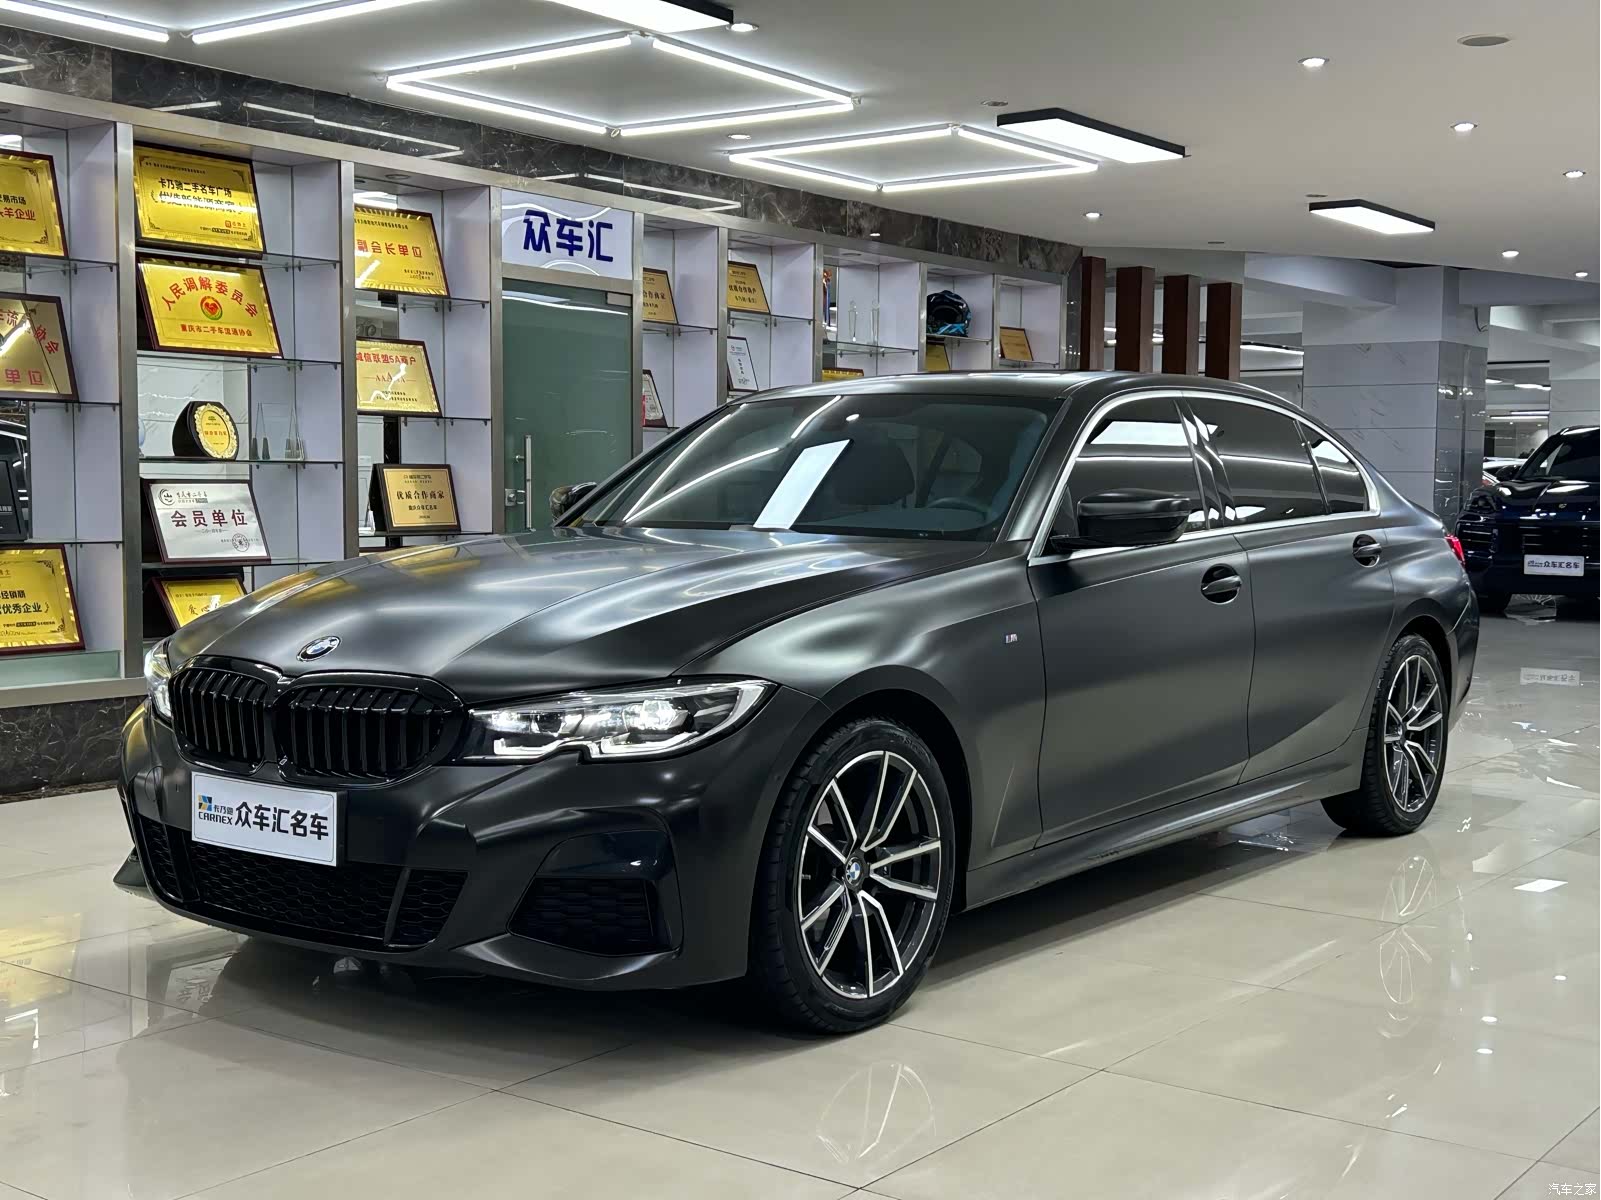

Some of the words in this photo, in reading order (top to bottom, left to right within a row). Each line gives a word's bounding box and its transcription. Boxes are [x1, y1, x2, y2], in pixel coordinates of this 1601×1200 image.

[523, 209, 614, 263] 众车汇
[161, 275, 259, 318] 人民调解委员会
[5, 368, 45, 385] 单位
[171, 508, 248, 528] 会员单位
[1543, 560, 1580, 569] 众车汇名车
[0, 590, 26, 599] 经销商
[0, 602, 43, 614] 优秀企业
[198, 812, 233, 826] CARNEX
[234, 801, 329, 841] 众车汇名车
